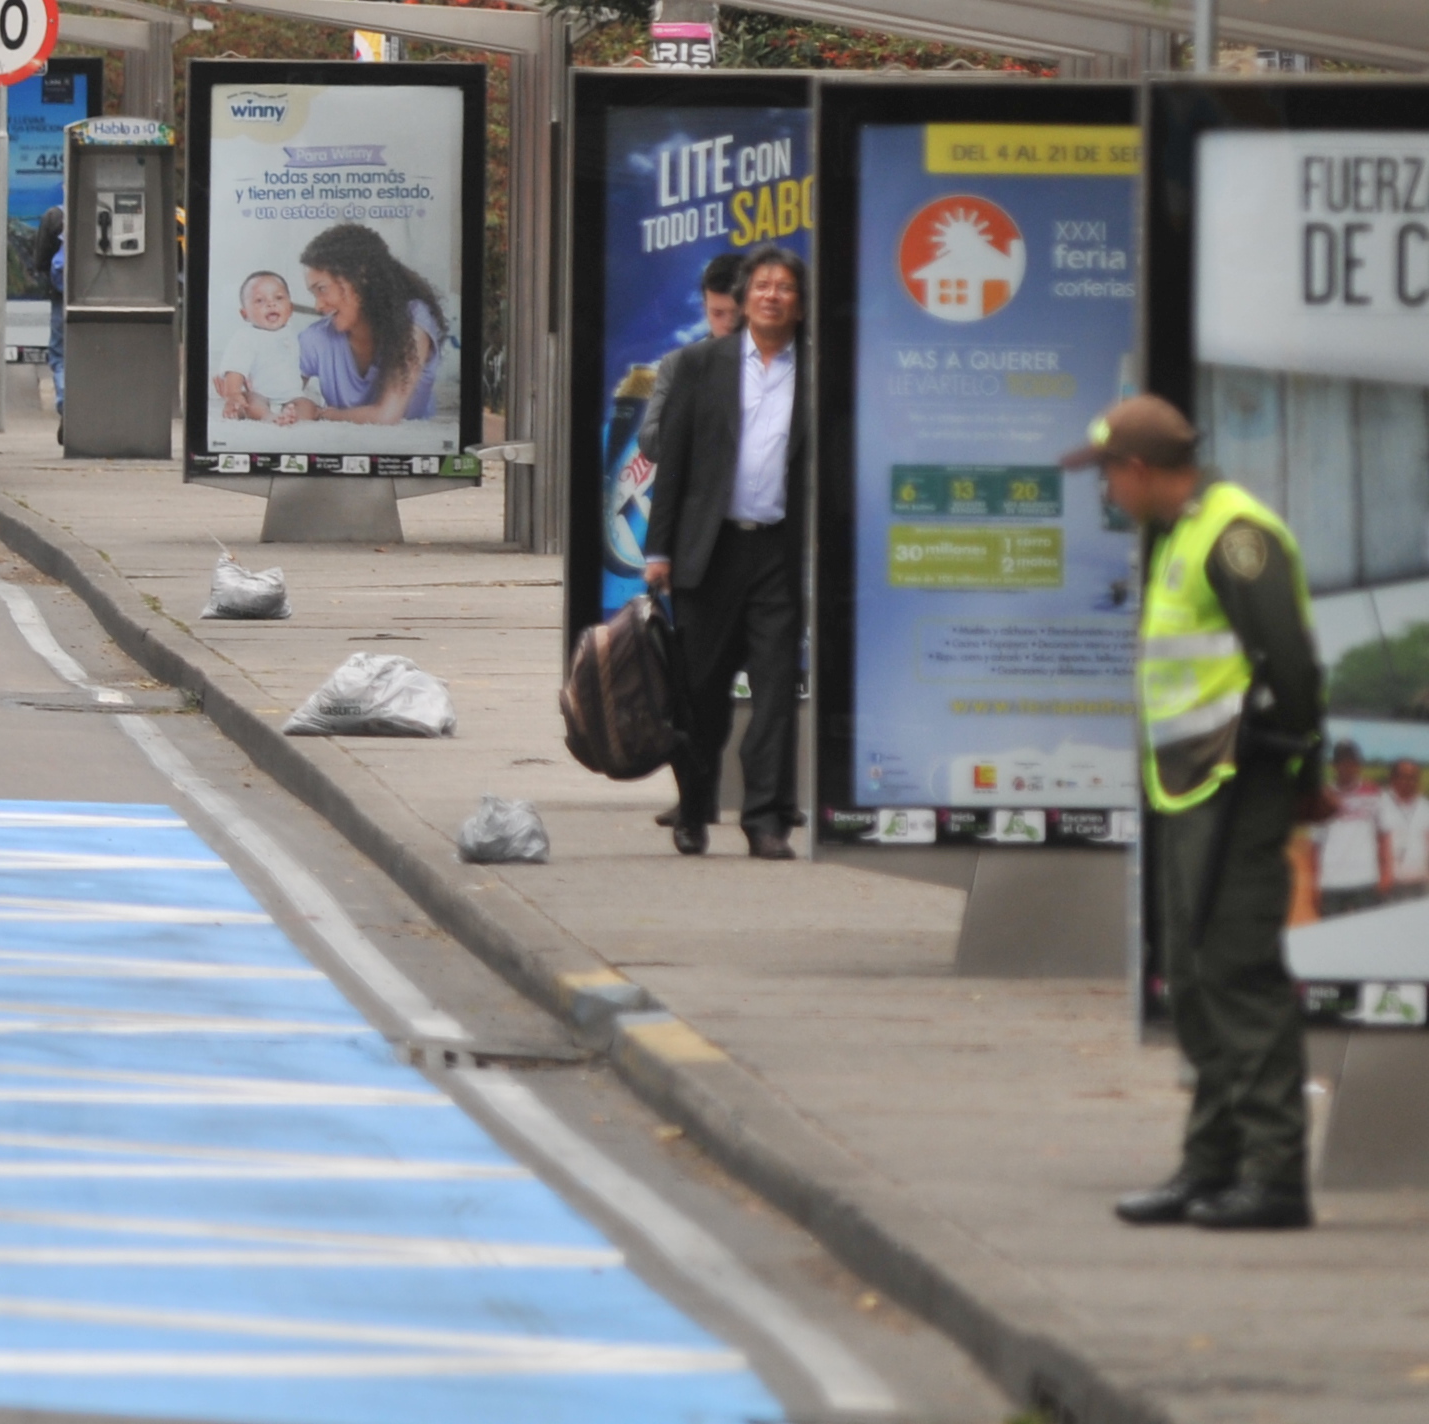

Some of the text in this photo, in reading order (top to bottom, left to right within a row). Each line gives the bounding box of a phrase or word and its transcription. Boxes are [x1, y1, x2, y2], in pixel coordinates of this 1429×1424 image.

[230, 99, 286, 122] winny
[93, 121, 131, 135] Habla
[295, 147, 373, 163] Para Winny
[951, 144, 989, 162] DEL
[997, 144, 1010, 161] 4
[1015, 145, 1041, 163] AL
[1048, 145, 1067, 163] 21
[1074, 146, 1100, 163] DE
[264, 169, 406, 185] todas son mamás
[660, 134, 791, 207] LITE CON
[235, 183, 435, 204] y tienen el mismo estado,
[1303, 154, 1429, 214] FUERZ
[254, 202, 415, 220] un estado de amor
[642, 207, 700, 253] TODO
[704, 201, 730, 238] EL
[1054, 221, 1108, 242] XXXI
[1054, 244, 1127, 270] feria
[1303, 221, 1373, 306] DE
[1054, 278, 1137, 298] corferias
[898, 350, 1061, 371] VAS A QUERER
[899, 480, 1039, 502] 6 13 20
[895, 542, 988, 562] 30 millones
[1001, 557, 1015, 573] 2
[833, 811, 877, 824] Descarga
